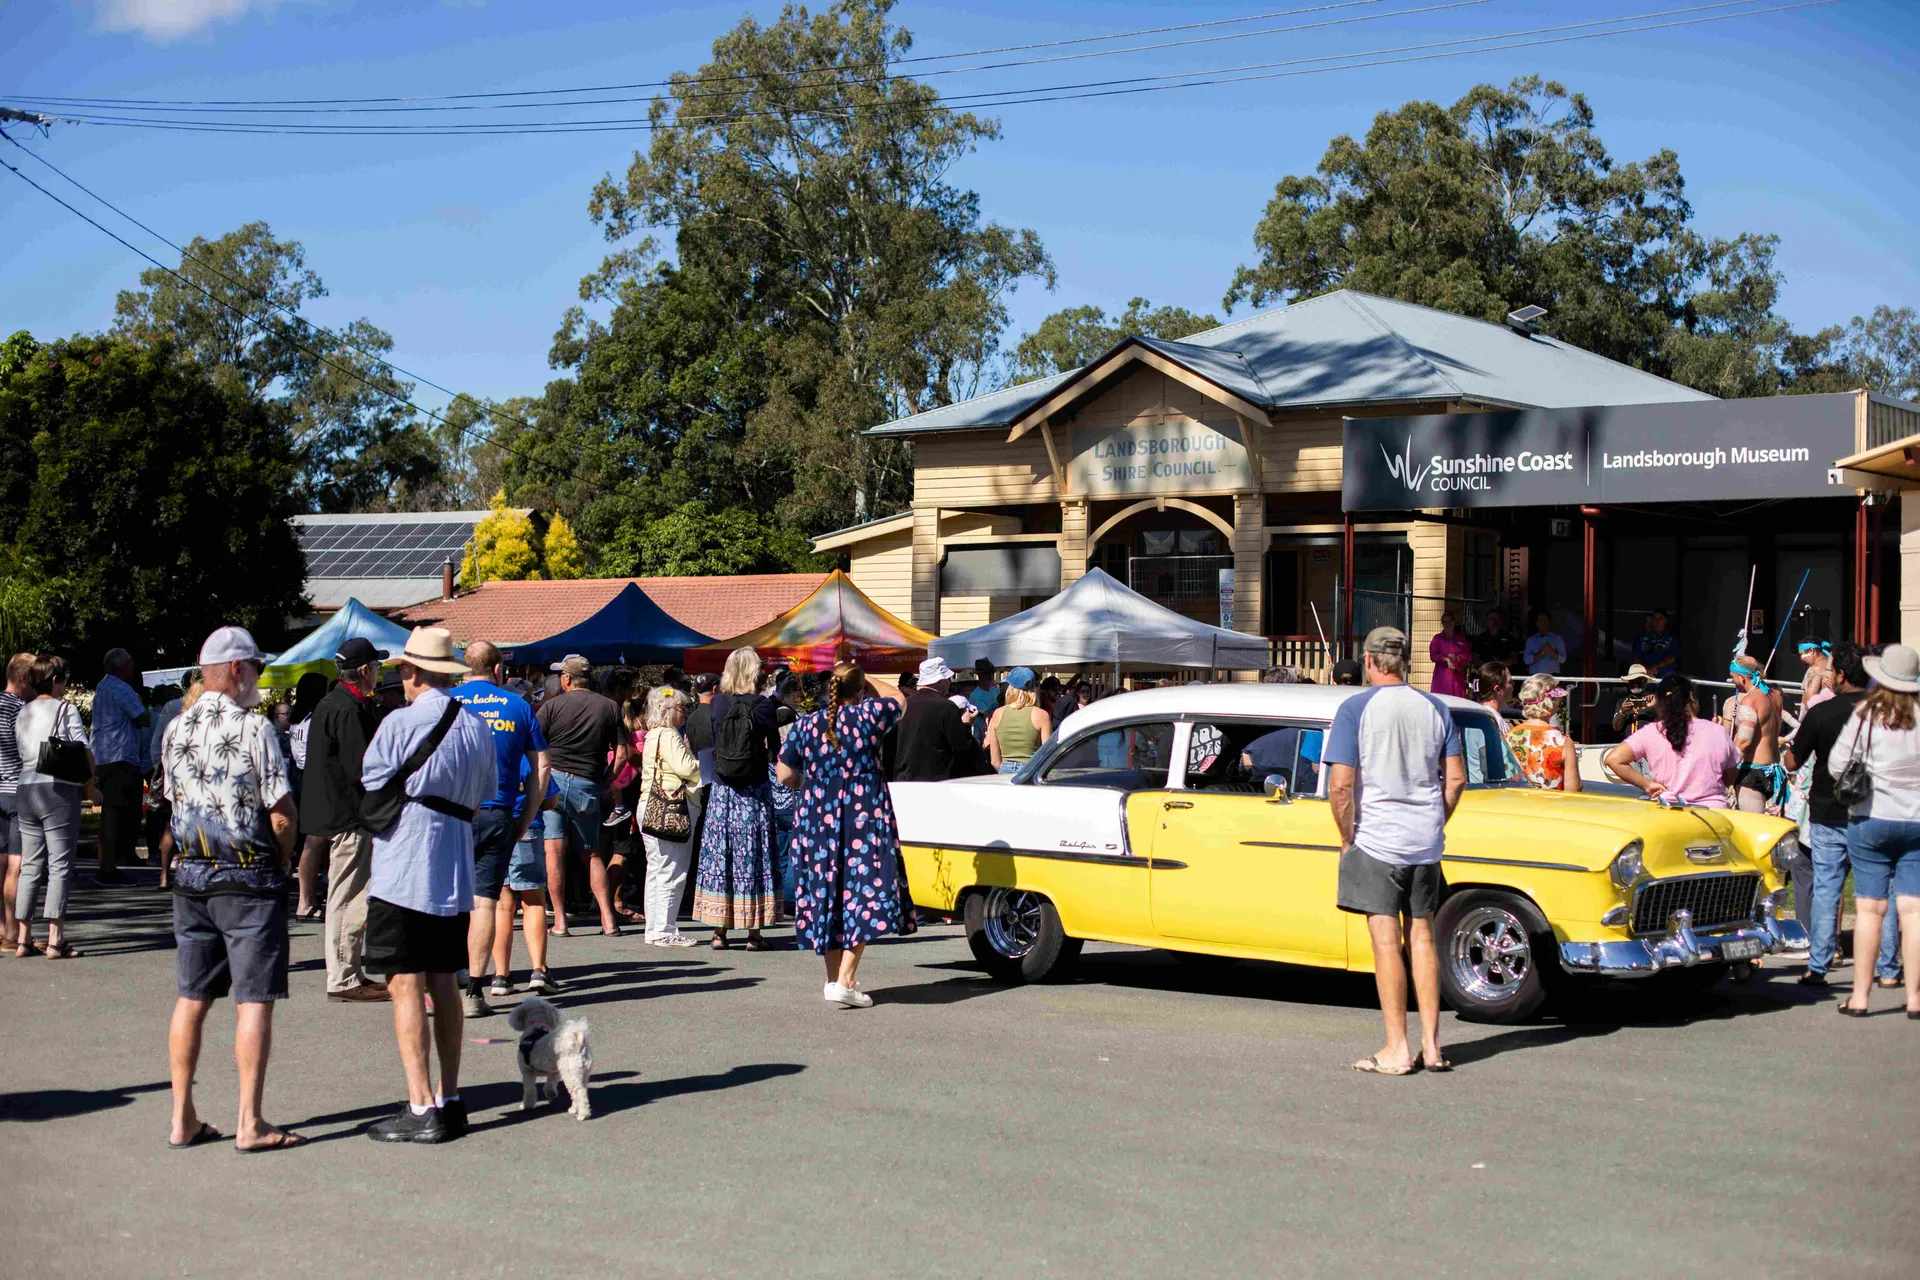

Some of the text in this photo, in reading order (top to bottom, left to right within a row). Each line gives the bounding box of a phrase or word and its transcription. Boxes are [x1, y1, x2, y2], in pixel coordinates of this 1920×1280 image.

[1094, 434, 1227, 459] LANDSBOROUGH
[1430, 450, 1573, 475] Sunshine Coast
[1603, 447, 1809, 469] Landsborough Museum
[1102, 464, 1146, 482] SHIRE
[1430, 476, 1491, 491] COUNCIL
[473, 693, 509, 705] backing
[486, 719, 516, 732] TON
